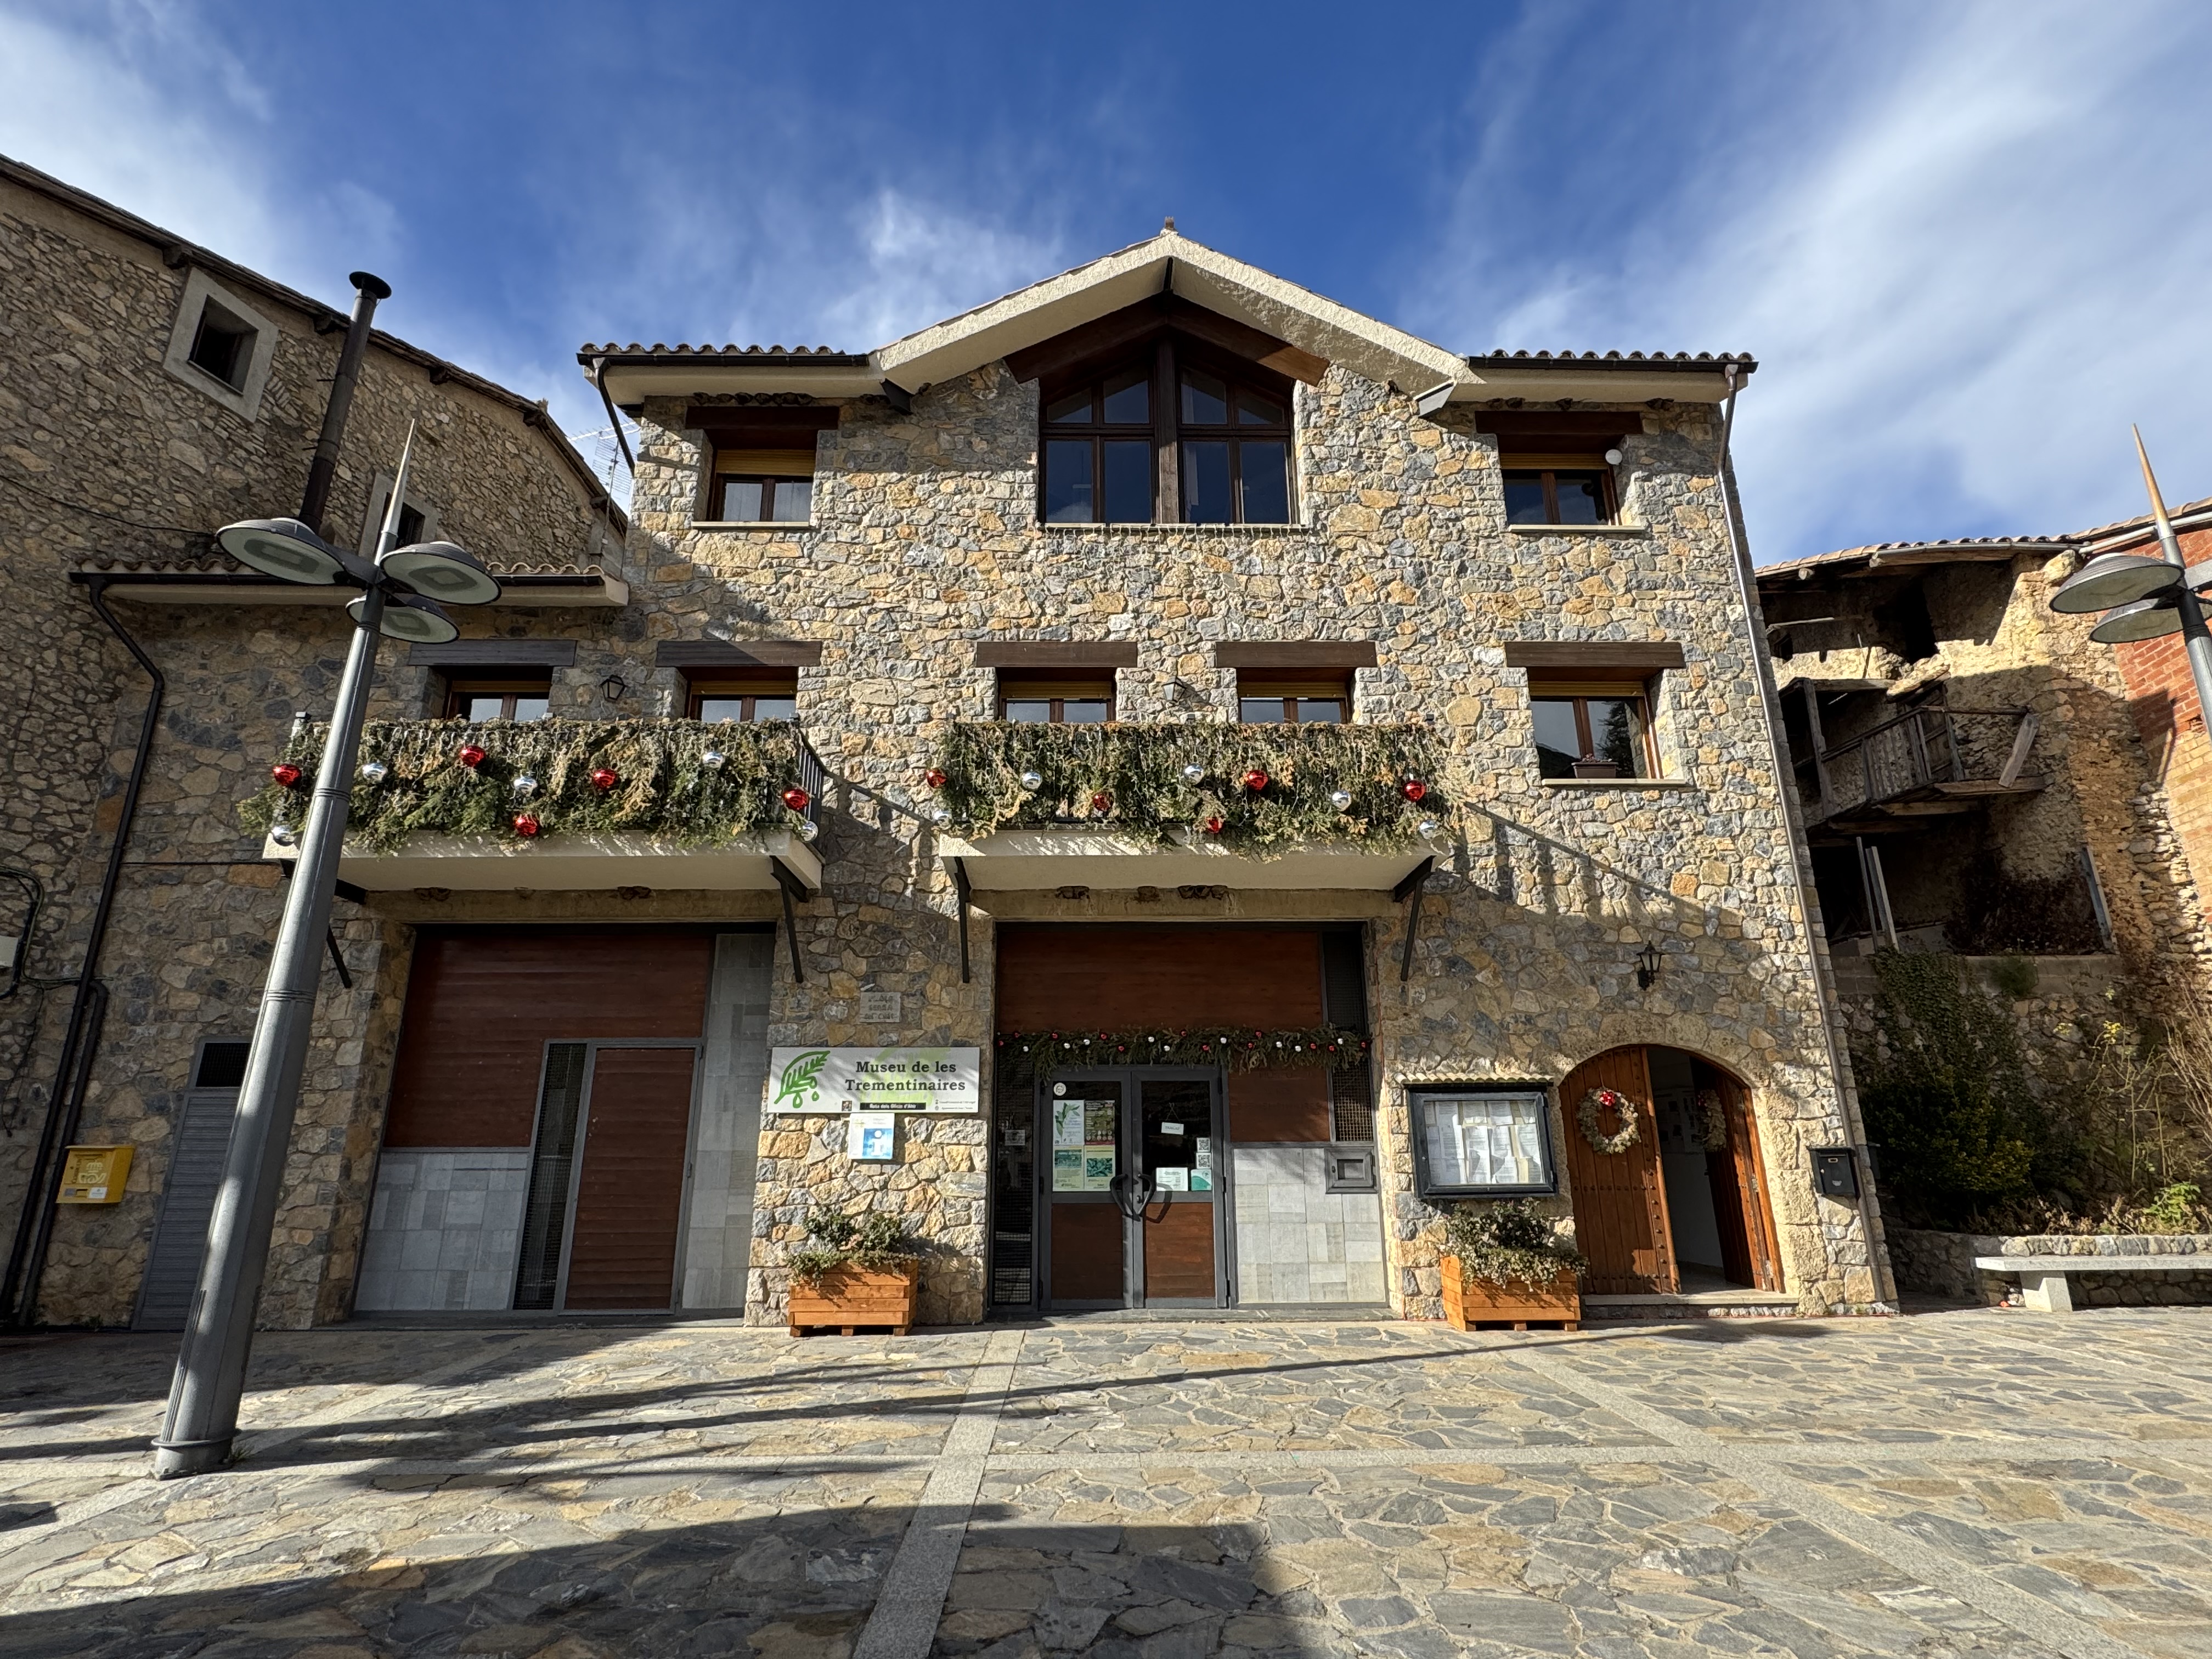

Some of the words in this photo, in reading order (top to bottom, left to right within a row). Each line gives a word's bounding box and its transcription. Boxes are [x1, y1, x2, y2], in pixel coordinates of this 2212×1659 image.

[856, 1061, 906, 1073] Museu
[911, 1061, 930, 1073] de
[935, 1061, 957, 1073] les
[845, 1079, 966, 1091] Trementinaires
